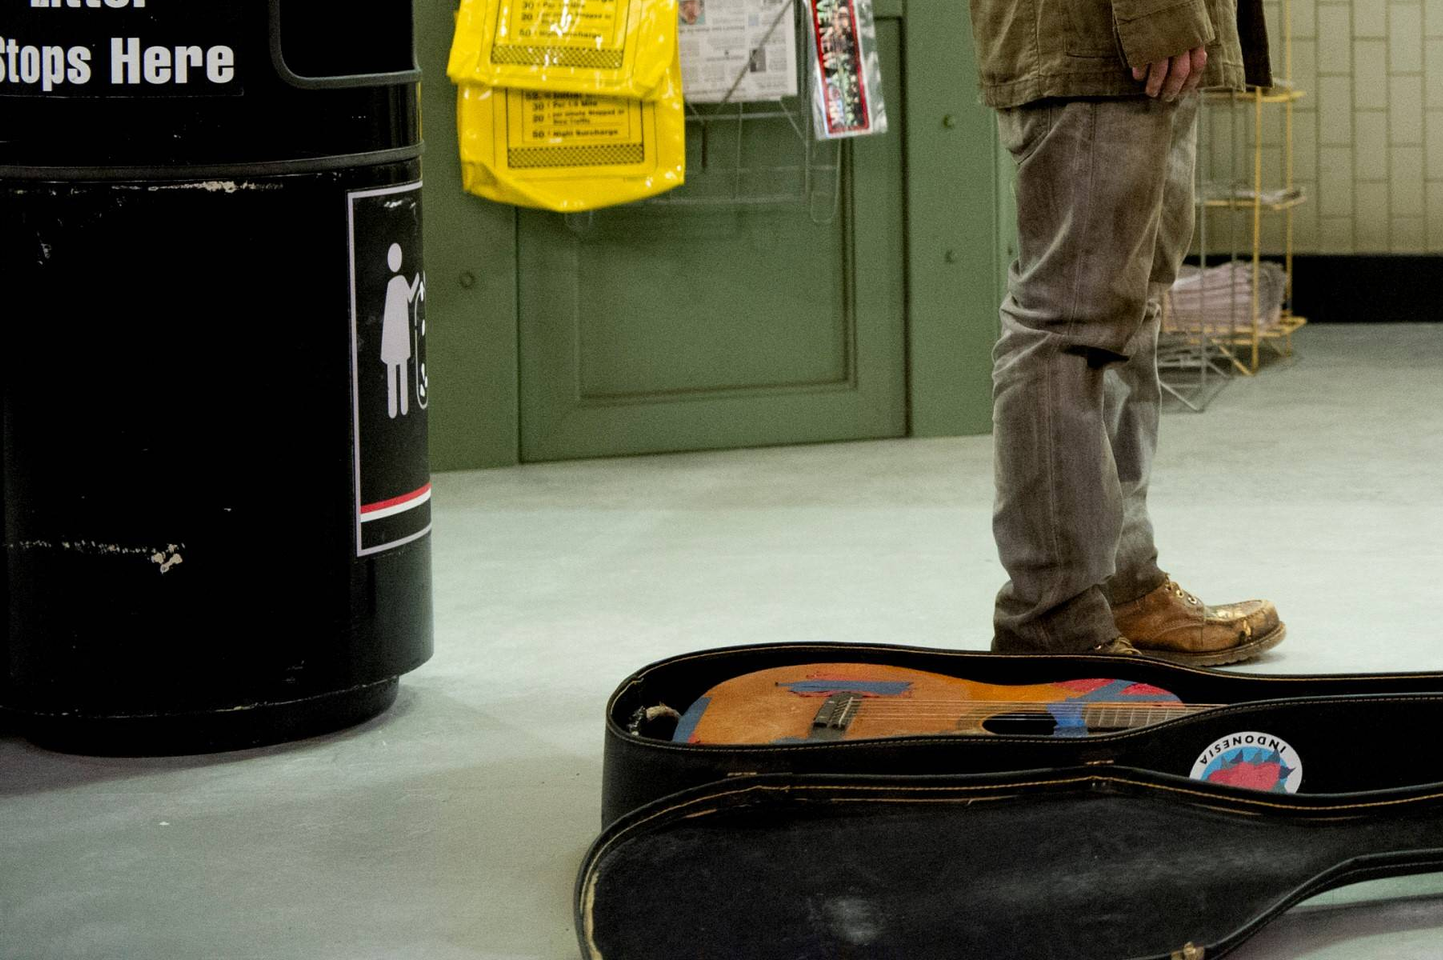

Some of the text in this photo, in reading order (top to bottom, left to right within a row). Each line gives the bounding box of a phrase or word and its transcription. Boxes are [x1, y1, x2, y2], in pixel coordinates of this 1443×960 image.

[0, 36, 235, 92] tops Here
[1199, 734, 1288, 766] INDONESIA
